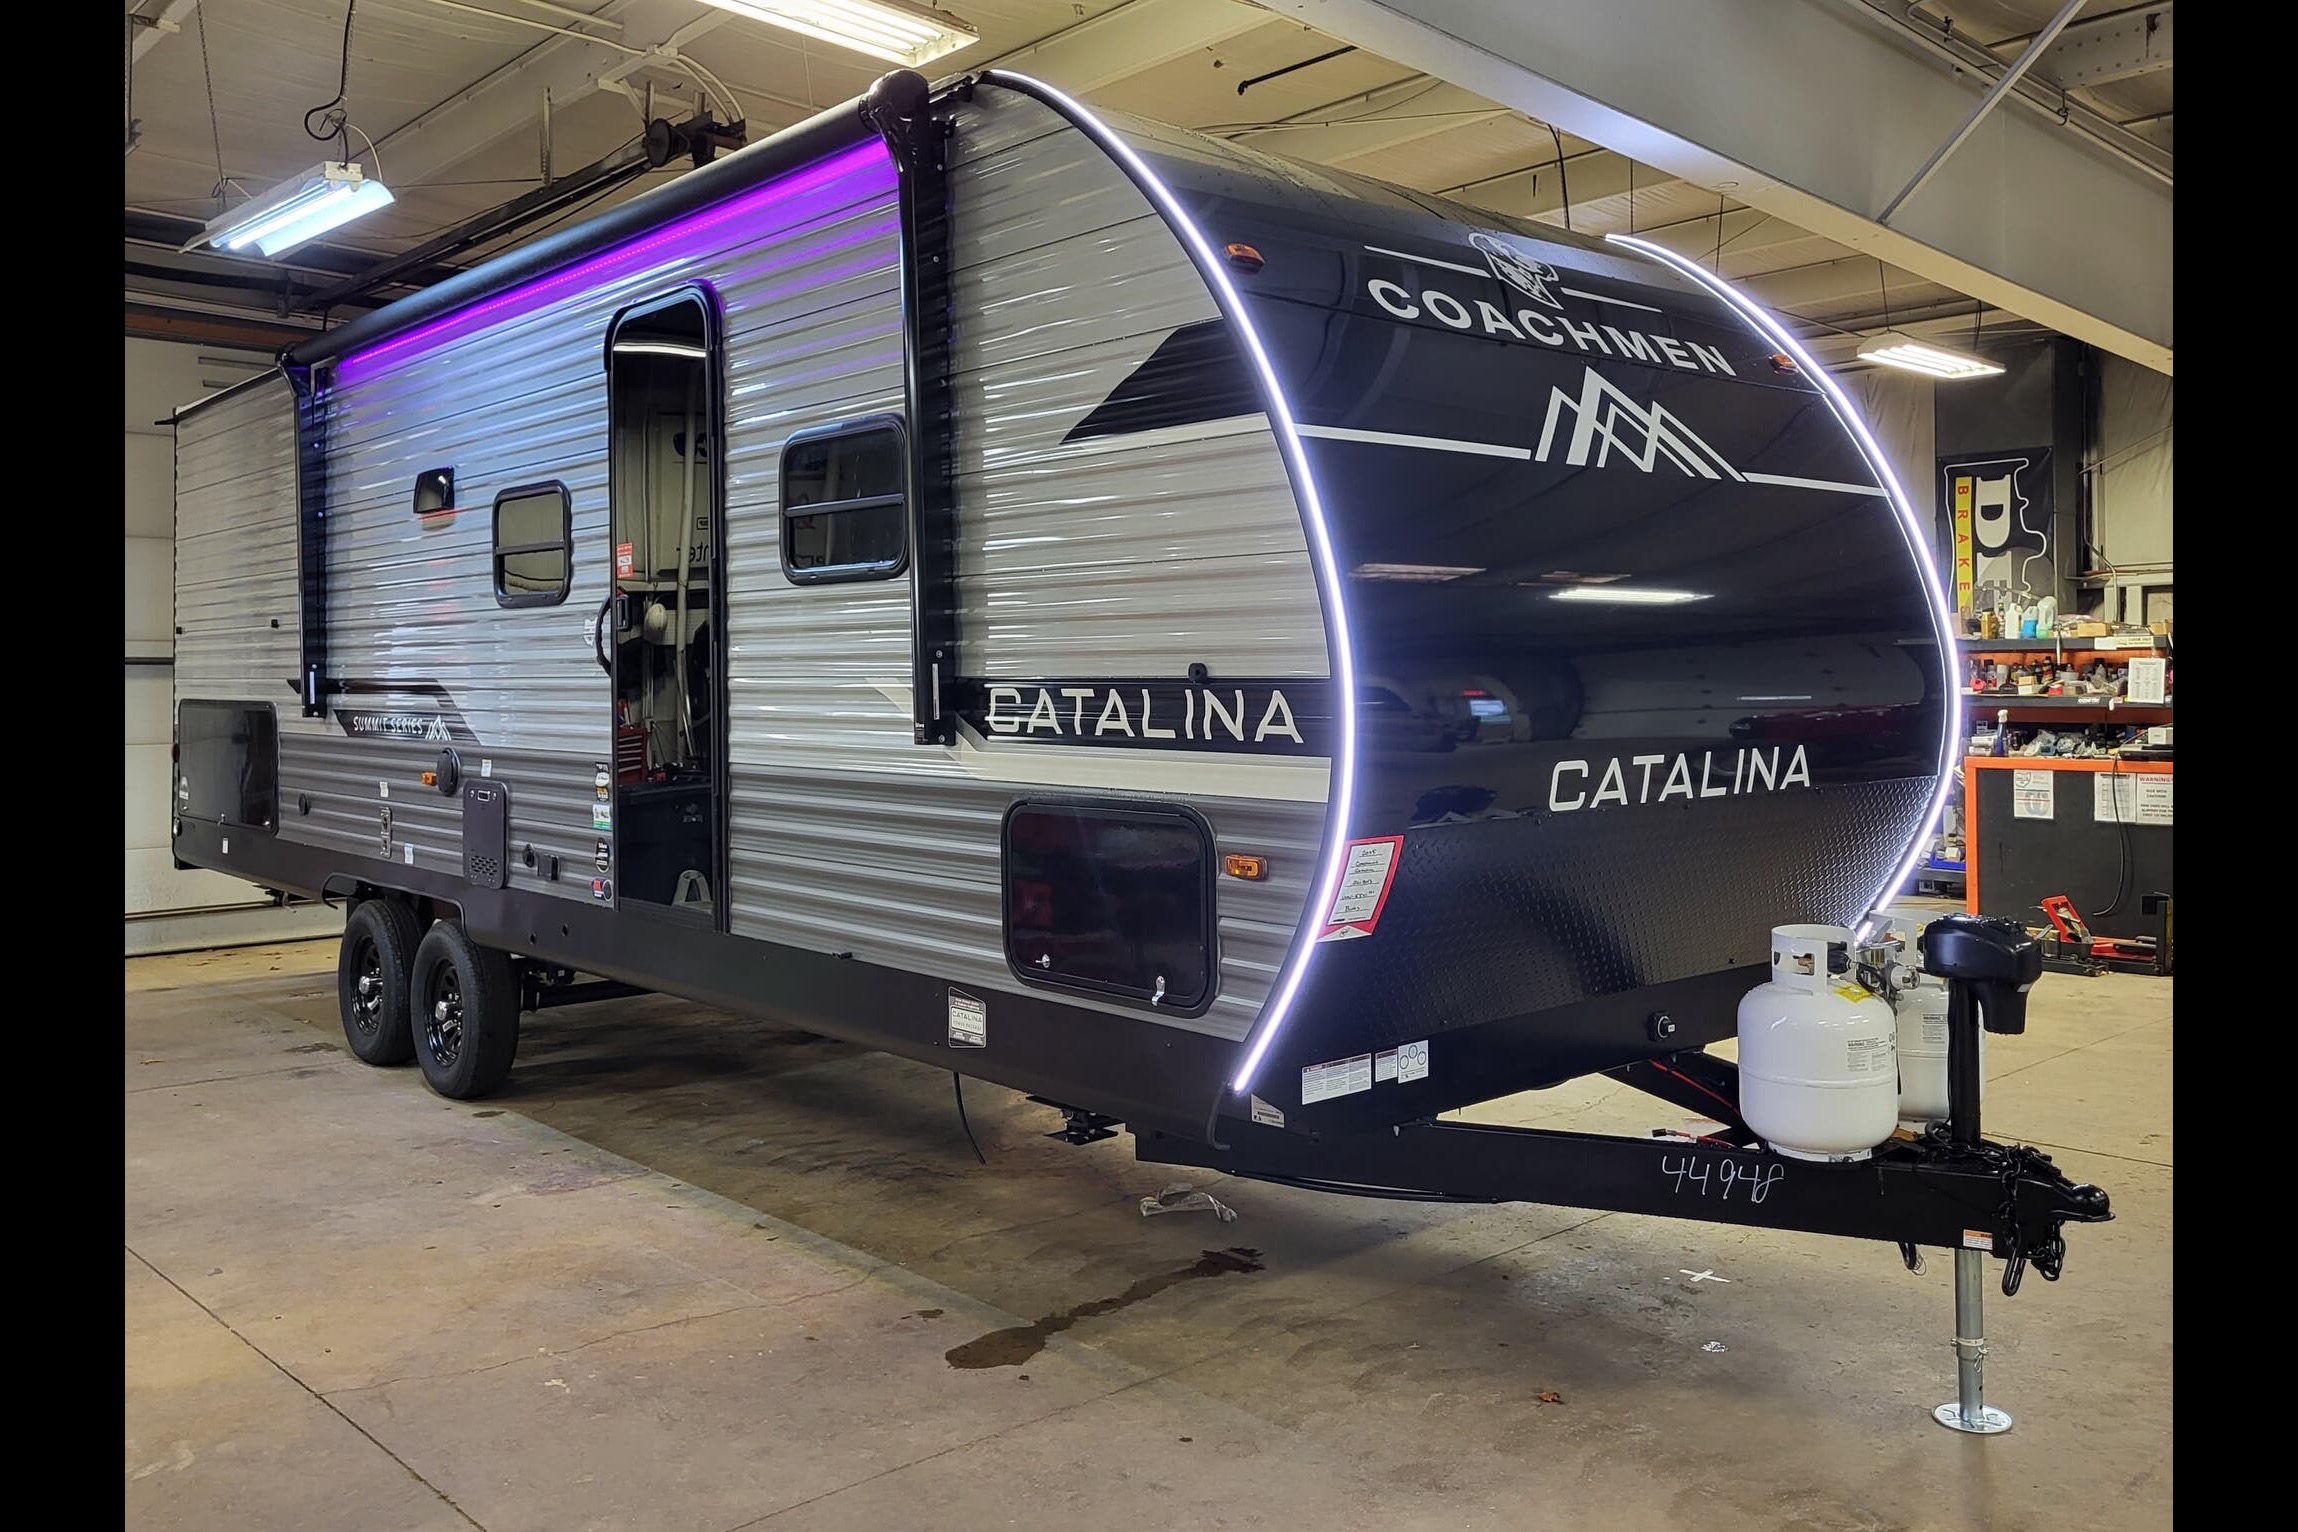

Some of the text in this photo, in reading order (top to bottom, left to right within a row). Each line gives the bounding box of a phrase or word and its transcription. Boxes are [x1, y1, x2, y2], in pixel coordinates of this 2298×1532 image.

[1367, 278, 1737, 377] COACHMEN
[1957, 485, 1971, 614] BRAKES
[353, 715, 423, 735] SUMMIT SERIES
[988, 687, 1304, 744] CATALINA
[1549, 744, 1811, 812] CATALINA
